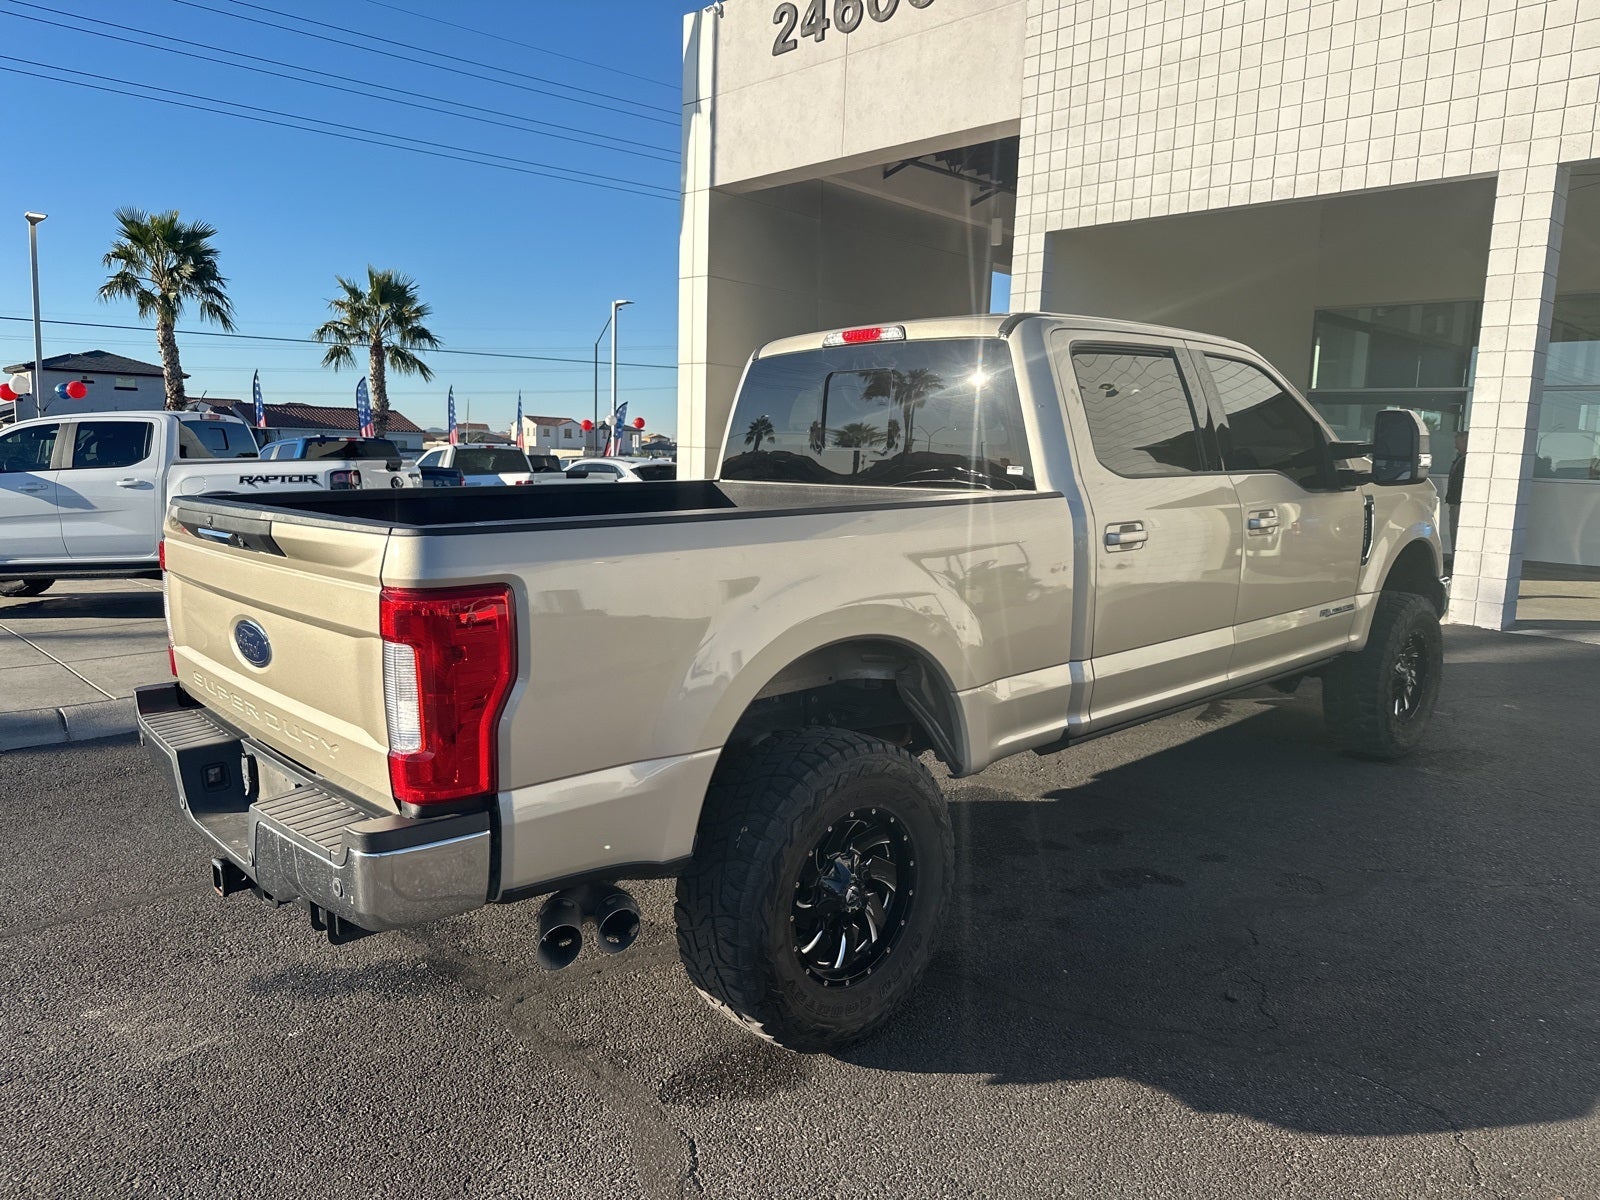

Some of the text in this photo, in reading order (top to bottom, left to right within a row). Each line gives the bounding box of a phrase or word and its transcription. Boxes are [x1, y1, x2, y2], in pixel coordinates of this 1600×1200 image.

[772, 0, 934, 56] 2460
[239, 474, 324, 489] RAPTOR
[193, 671, 339, 759] SUPER DUTY
